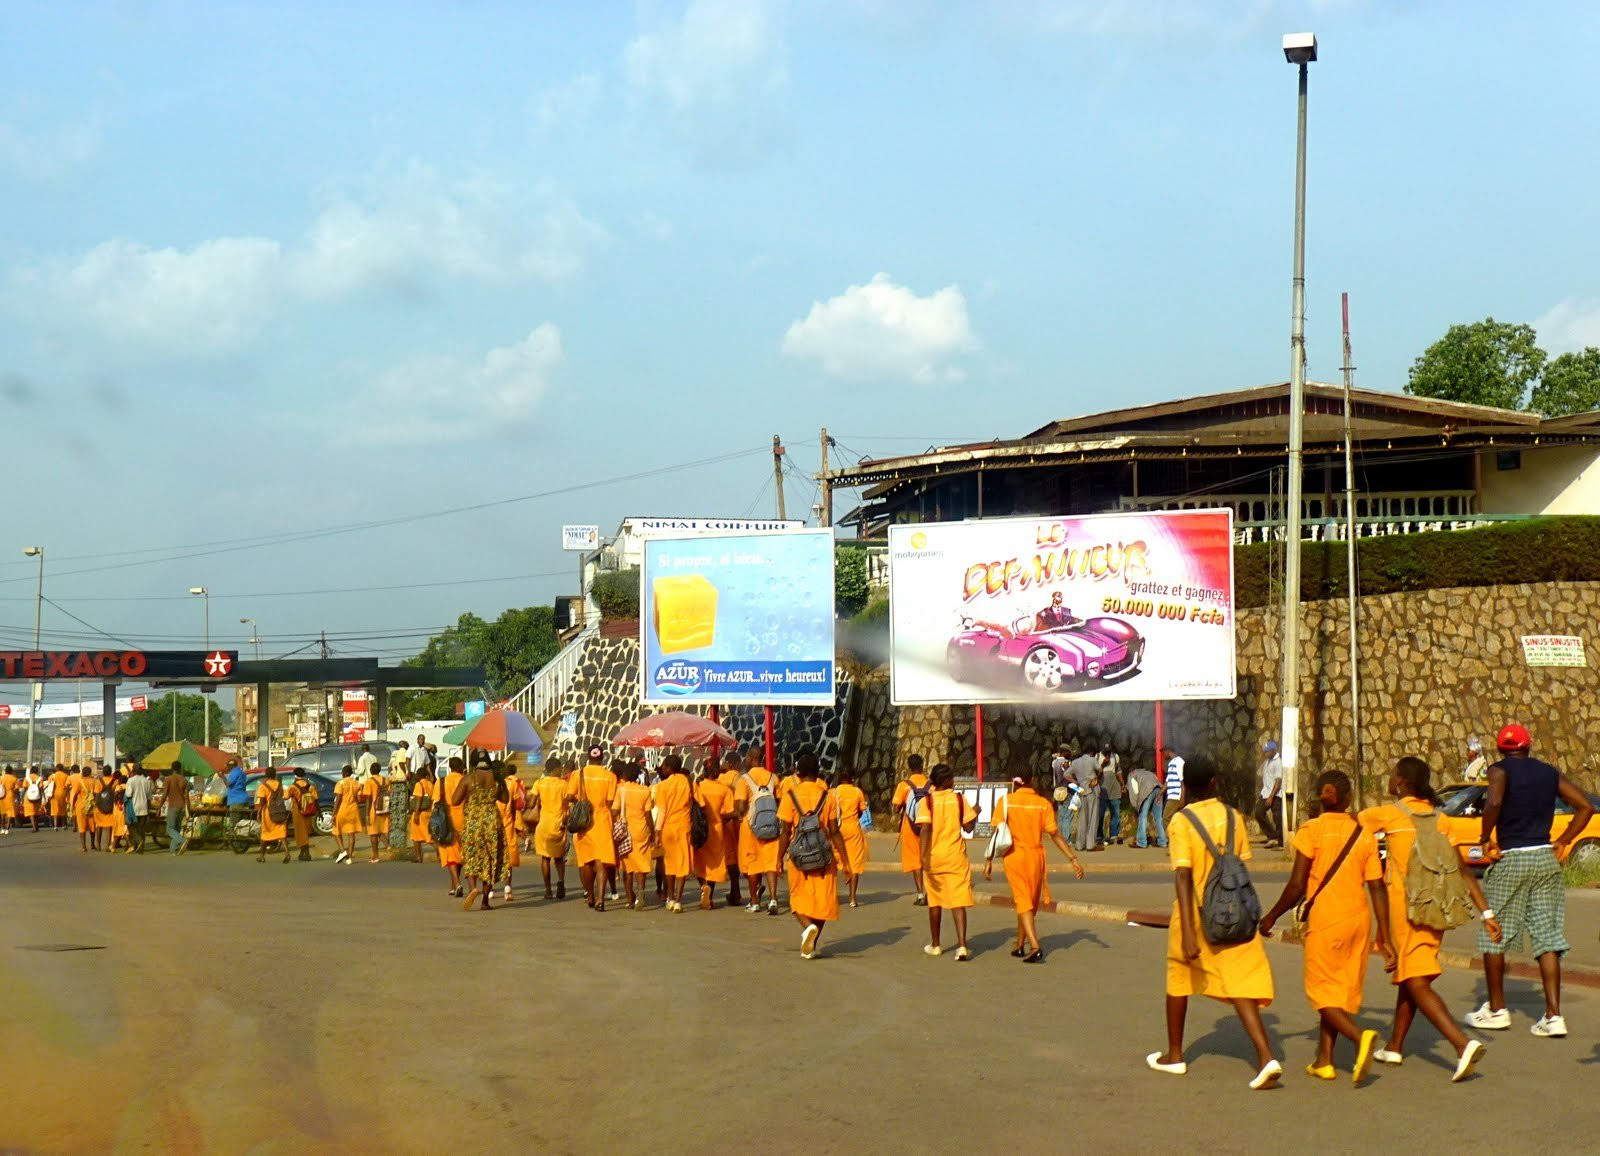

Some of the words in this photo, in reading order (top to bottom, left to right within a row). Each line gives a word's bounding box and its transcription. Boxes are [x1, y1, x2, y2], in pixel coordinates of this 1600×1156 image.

[1131, 581, 1169, 596] grattez
[1171, 584, 1182, 597] et
[1185, 587, 1224, 602] gagnez
[1102, 597, 1154, 618] 50.000
[1157, 603, 1187, 621] 000
[1190, 606, 1225, 626] Fcfa
[0, 651, 147, 678] TEXACO
[656, 666, 700, 680] AZUR
[704, 668, 727, 683] Vivre
[785, 668, 826, 683] heureux!
